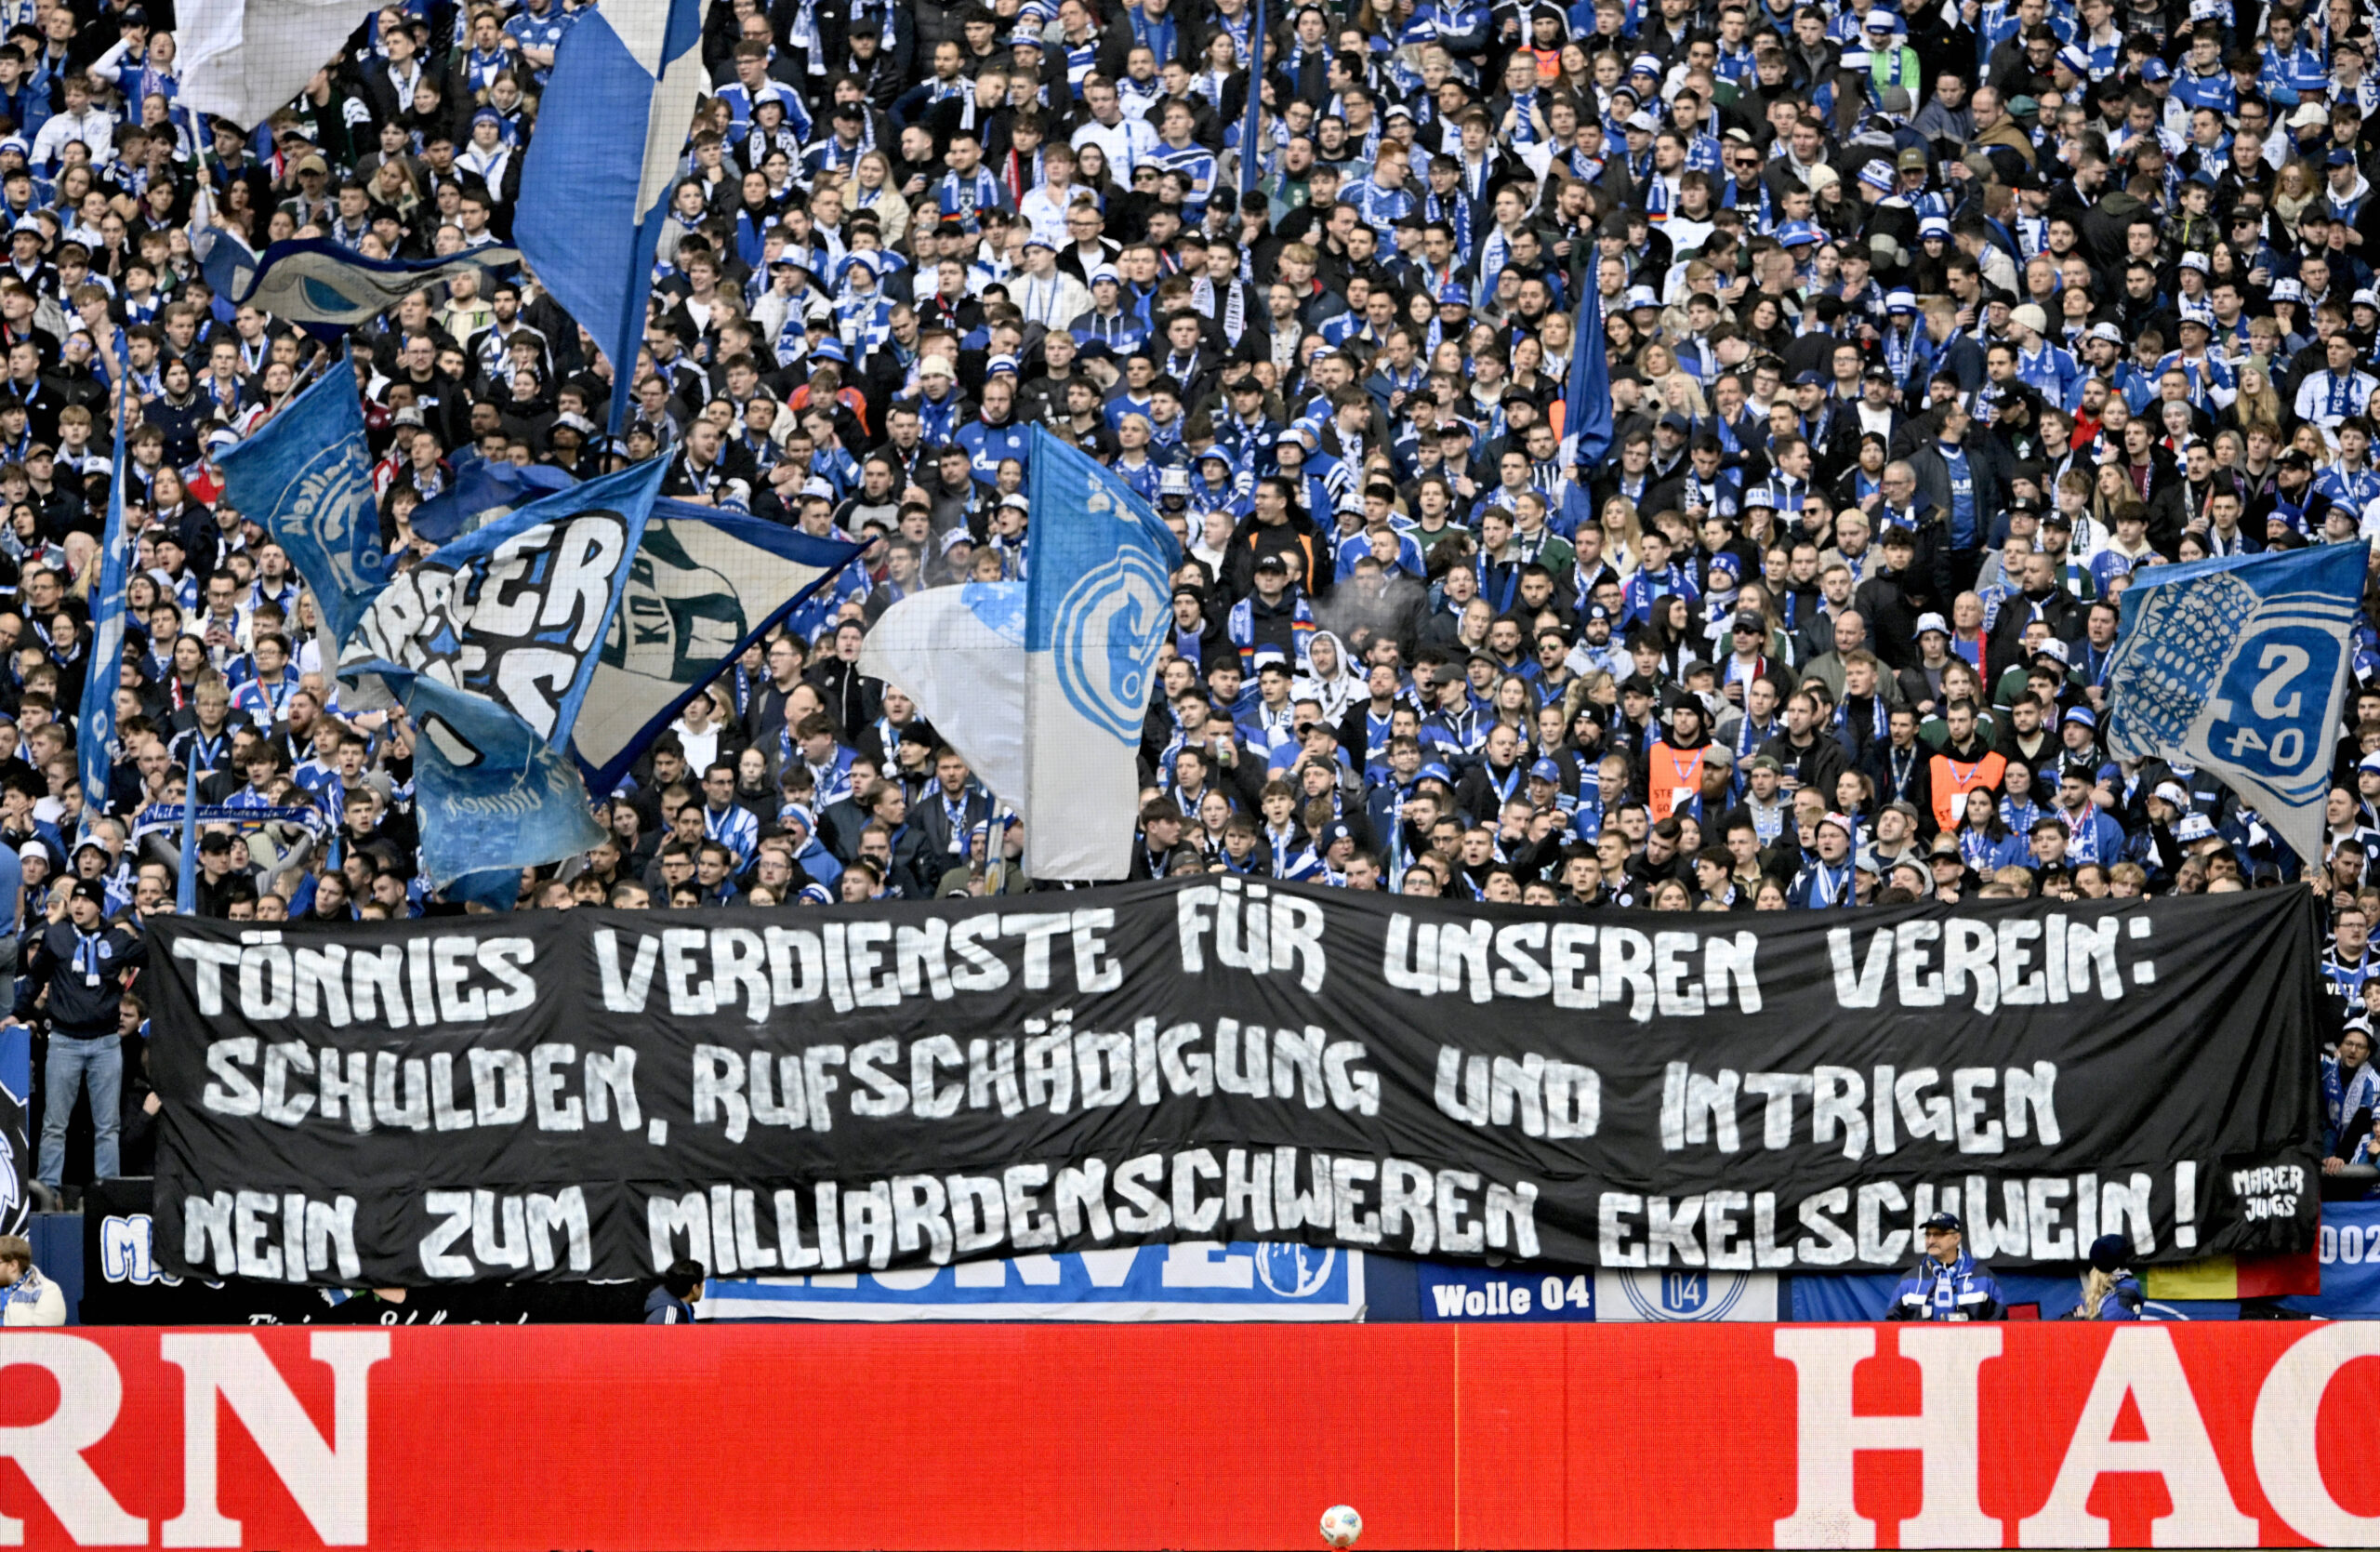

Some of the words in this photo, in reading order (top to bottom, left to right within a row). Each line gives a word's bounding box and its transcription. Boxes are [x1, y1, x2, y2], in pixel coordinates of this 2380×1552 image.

[173, 931, 536, 1028] TÖNNIES
[594, 908, 1123, 1023] VERDIENSTE
[1177, 876, 1326, 993] FÜR
[1383, 912, 1763, 1023] UNSEREN
[1827, 913, 2155, 1015] VEREIN:
[204, 1037, 668, 1146] SCHULDEN,
[693, 1008, 1381, 1144] RUFSCHÄDIGUNG
[1435, 1045, 1601, 1138] UND
[1660, 1061, 2061, 1161] INTRIGEN
[185, 1190, 361, 1281] NEIN
[419, 1186, 591, 1278] ZUM
[648, 1146, 1540, 1275] MILLIARDENSCHWEREN
[2245, 1195, 2297, 1222] JUNGS
[1433, 1281, 1531, 1317] Wolle
[1540, 1275, 1590, 1311] 04
[1670, 1271, 1701, 1310] 04
[0, 1331, 391, 1548] RN
